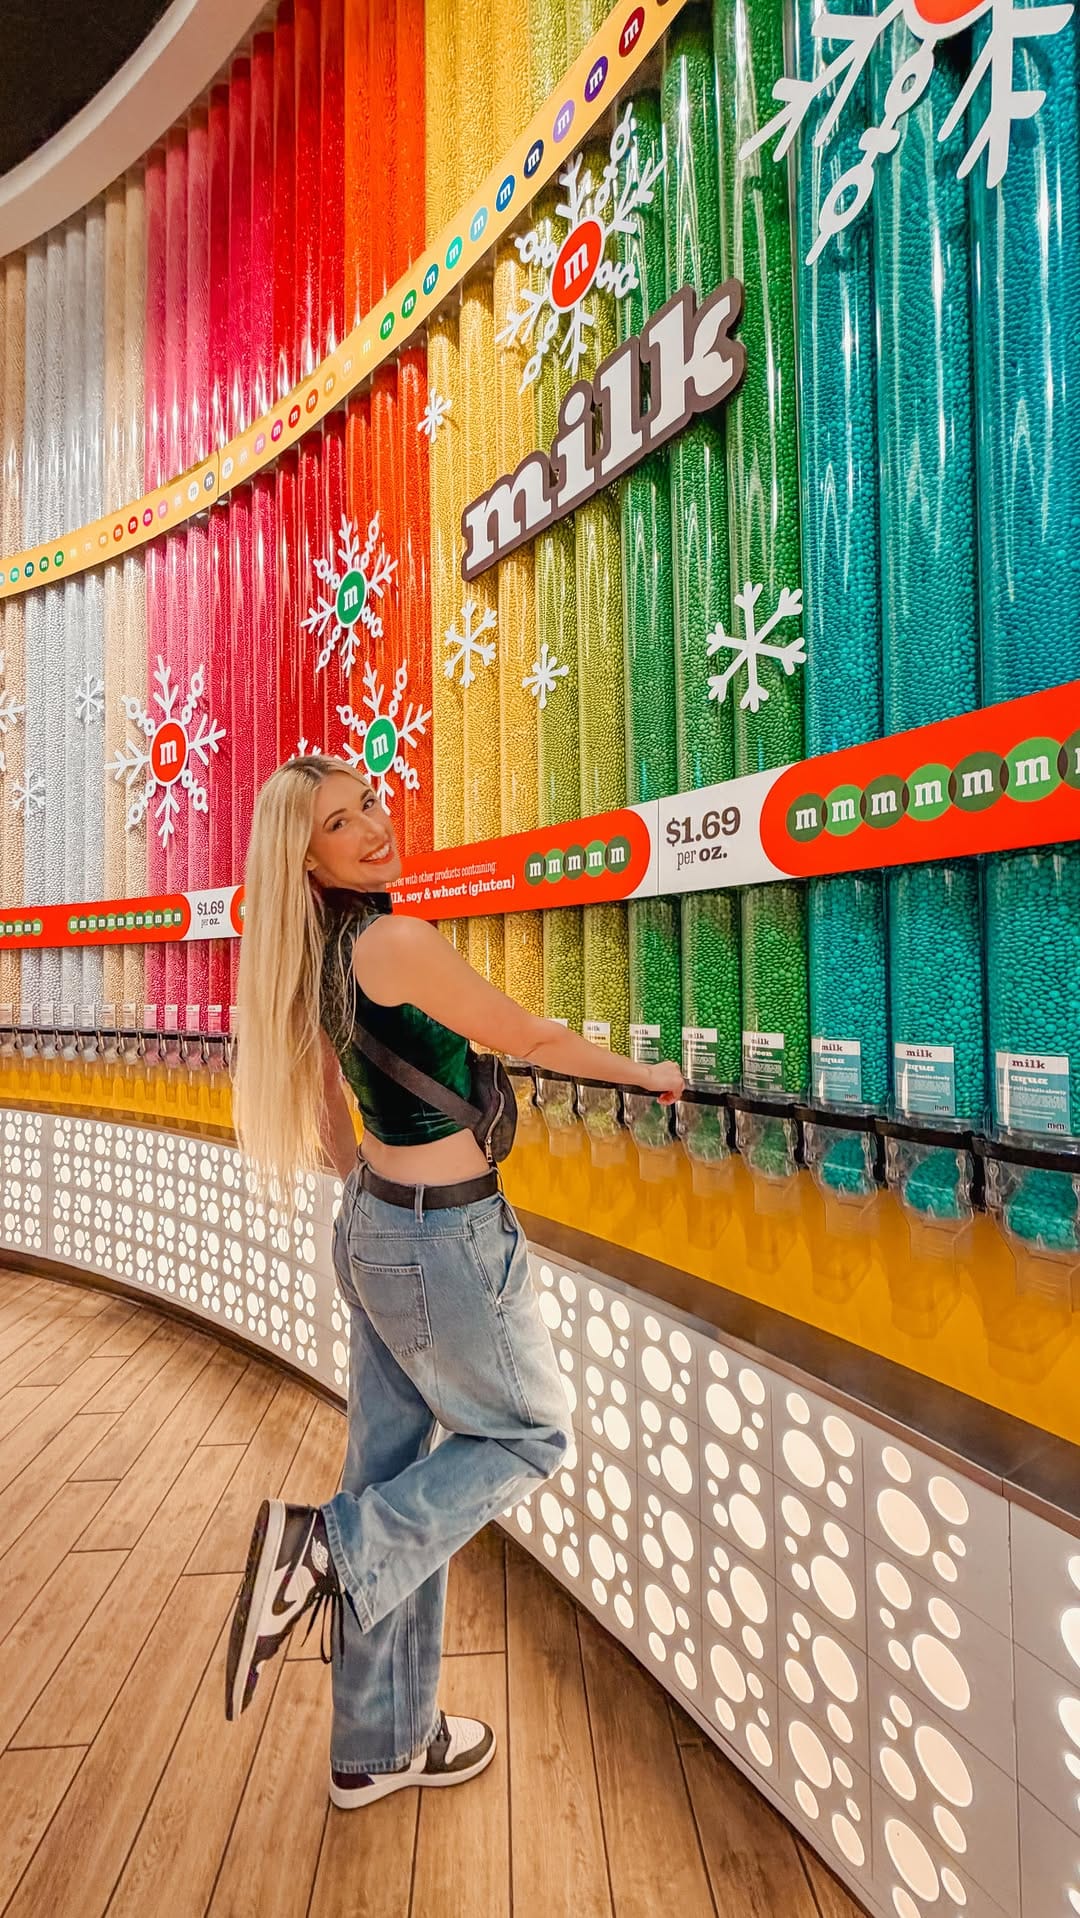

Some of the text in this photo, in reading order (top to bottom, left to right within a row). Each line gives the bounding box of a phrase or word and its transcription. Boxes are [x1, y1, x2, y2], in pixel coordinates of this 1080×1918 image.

[383, 318, 392, 334] m
[404, 296, 414, 313] m
[426, 271, 436, 289] m
[449, 244, 459, 263] m
[473, 215, 484, 235] m
[500, 183, 511, 204] m
[527, 149, 540, 172] m
[557, 109, 570, 135] m
[589, 66, 603, 94] m
[624, 18, 639, 49] m
[563, 243, 588, 289] m
[465, 294, 733, 572] milk
[344, 585, 358, 611] m
[159, 741, 176, 765] m
[372, 735, 387, 759] m
[795, 806, 818, 831] m
[831, 797, 856, 822] m
[870, 788, 898, 814] m
[914, 777, 944, 807] m
[961, 765, 994, 798] m
[1015, 753, 1051, 787] m
[665, 805, 741, 847] $1.69
[529, 845, 626, 878] m m m m m
[677, 844, 728, 871] per oz.
[405, 874, 418, 885] with
[418, 871, 434, 883] other
[434, 866, 461, 884] products
[390, 874, 515, 904] ilk, soy & wheat (gluten)
[197, 900, 225, 916] $1.69
[209, 918, 220, 926] oz.
[821, 1043, 843, 1052] milk
[905, 1049, 933, 1058] milk
[1012, 1058, 1046, 1069] milk
[1010, 1074, 1049, 1085] aqua
